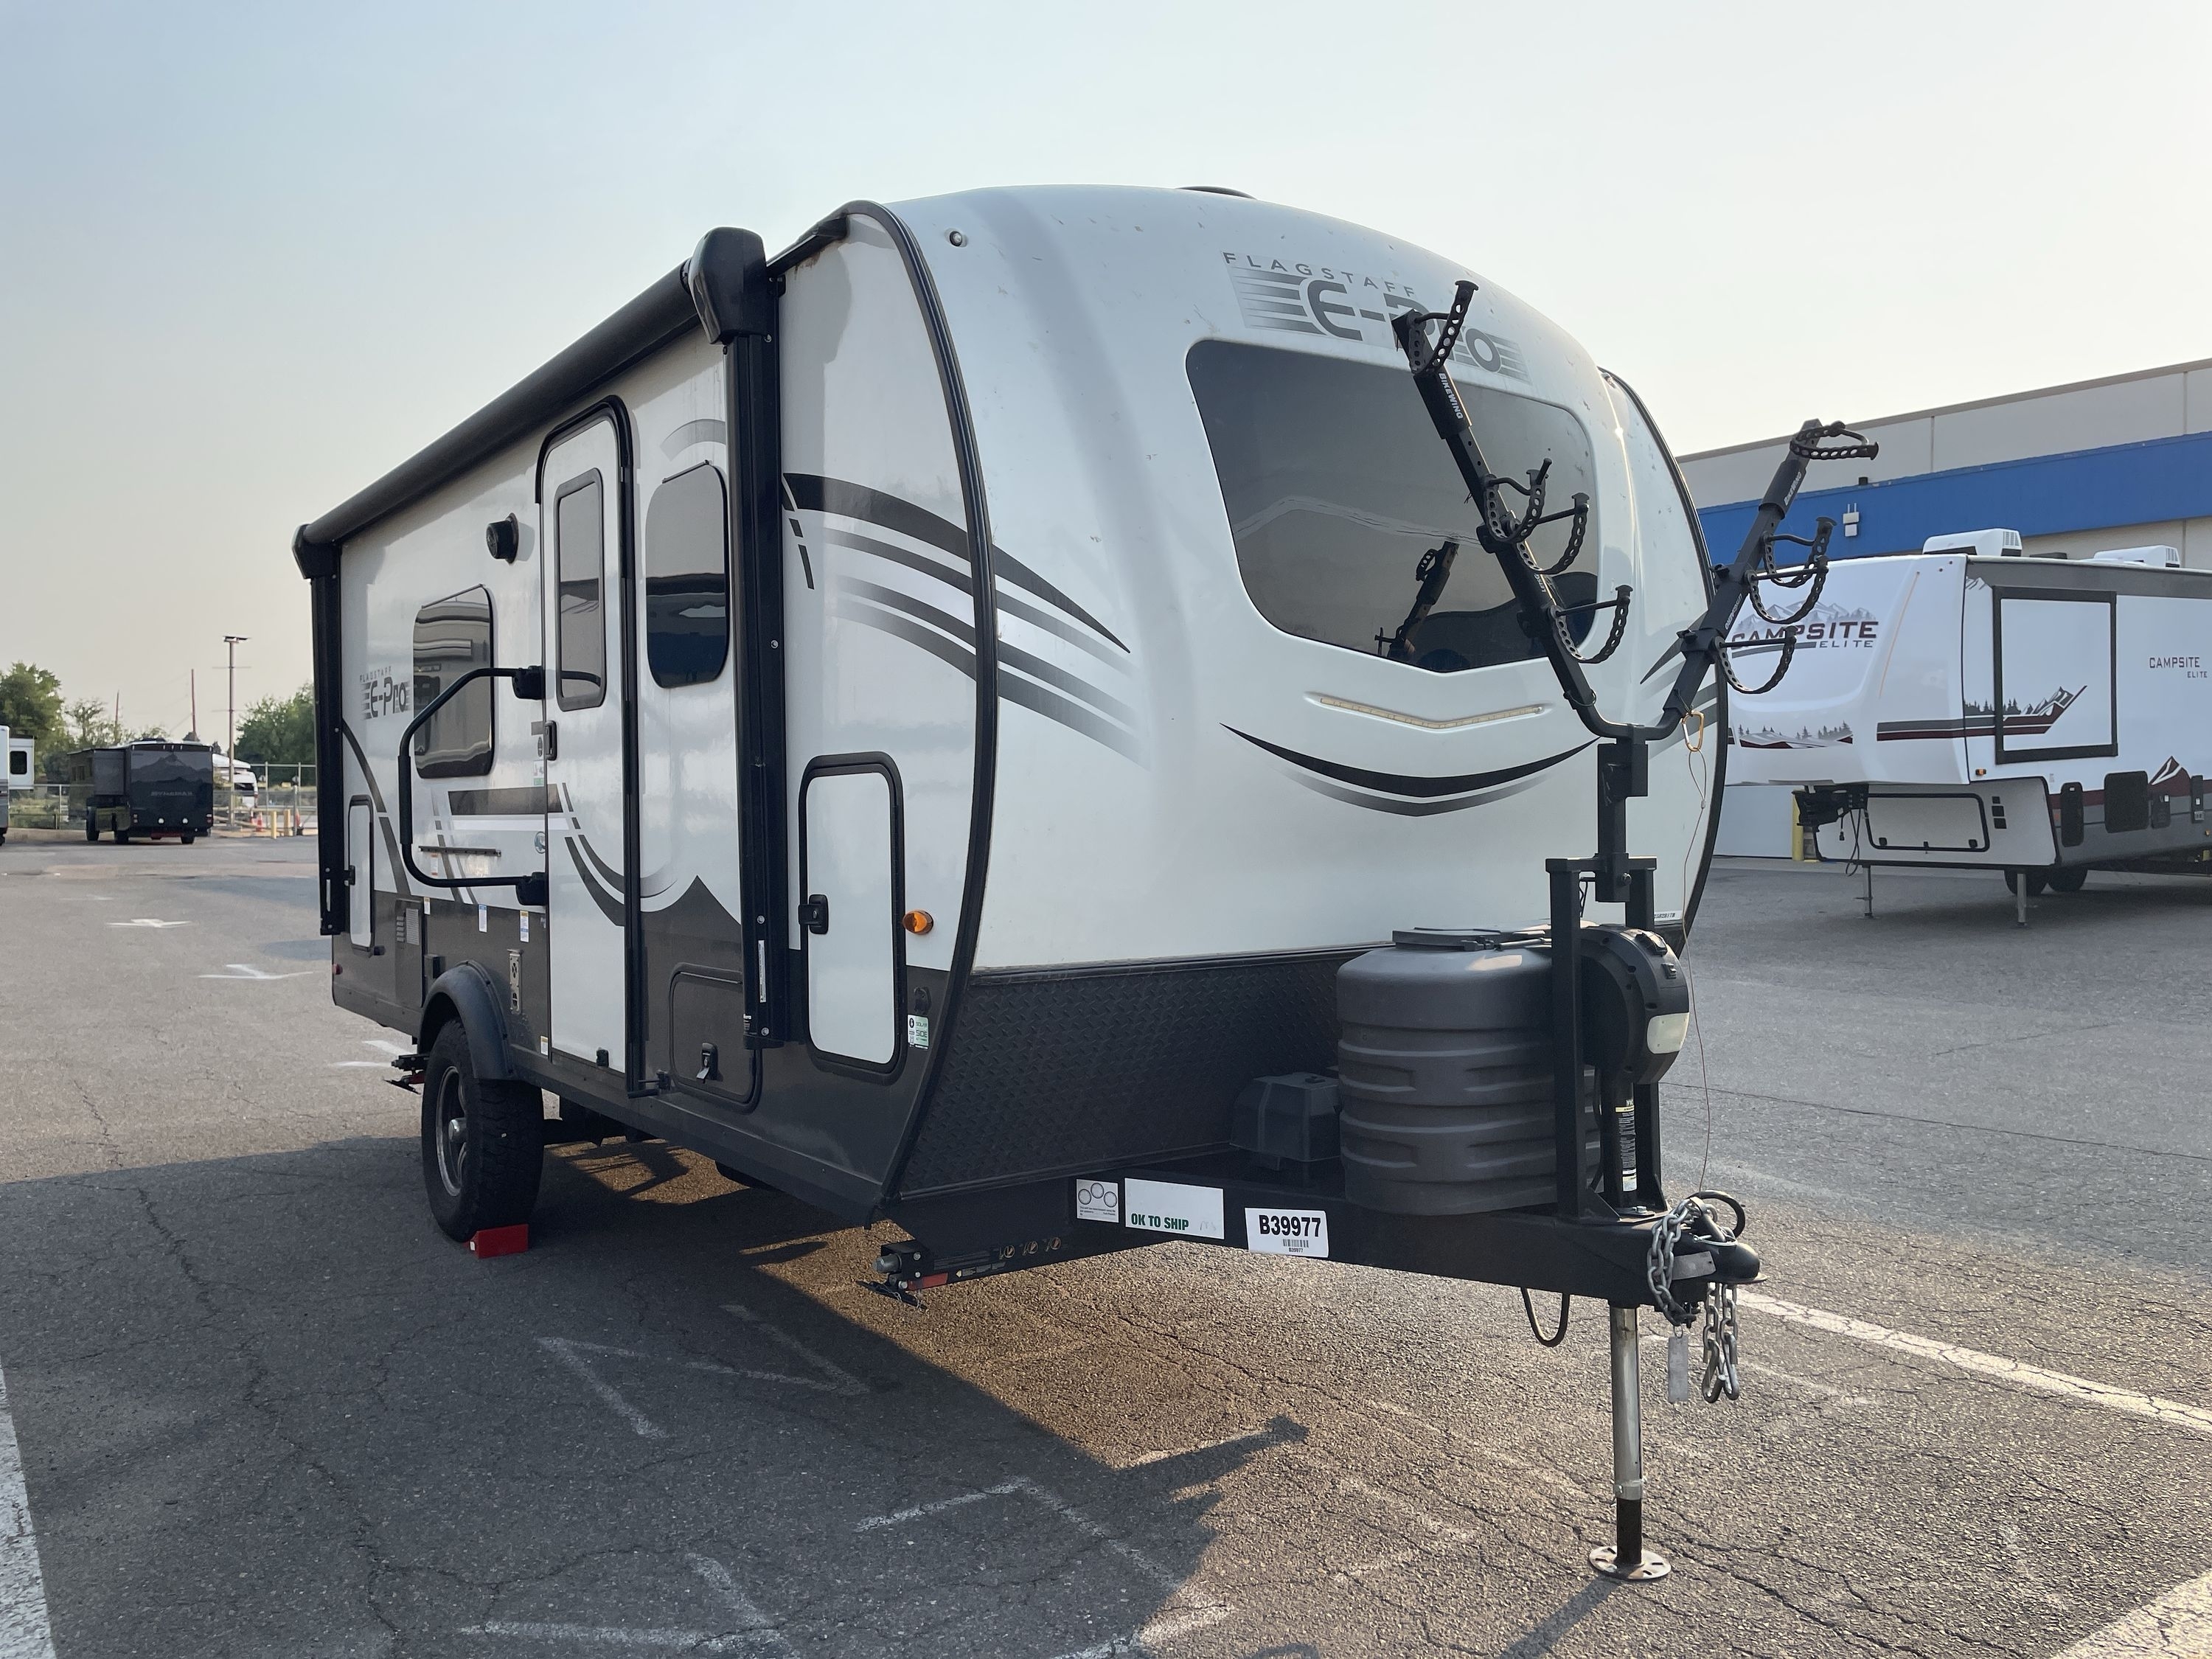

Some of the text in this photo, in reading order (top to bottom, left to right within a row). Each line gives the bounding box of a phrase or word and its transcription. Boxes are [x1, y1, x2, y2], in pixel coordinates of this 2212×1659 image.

[1222, 251, 1415, 297] FLAGSTAFF
[1439, 372, 1464, 420] BIKEWING
[1820, 640, 1874, 648] ELITE
[2149, 656, 2200, 669] CAMPSITE
[1131, 1213, 1145, 1225] OK
[1148, 1215, 1161, 1228] TO
[1164, 1217, 1189, 1231] SHIP
[1259, 1214, 1321, 1237] B39977
